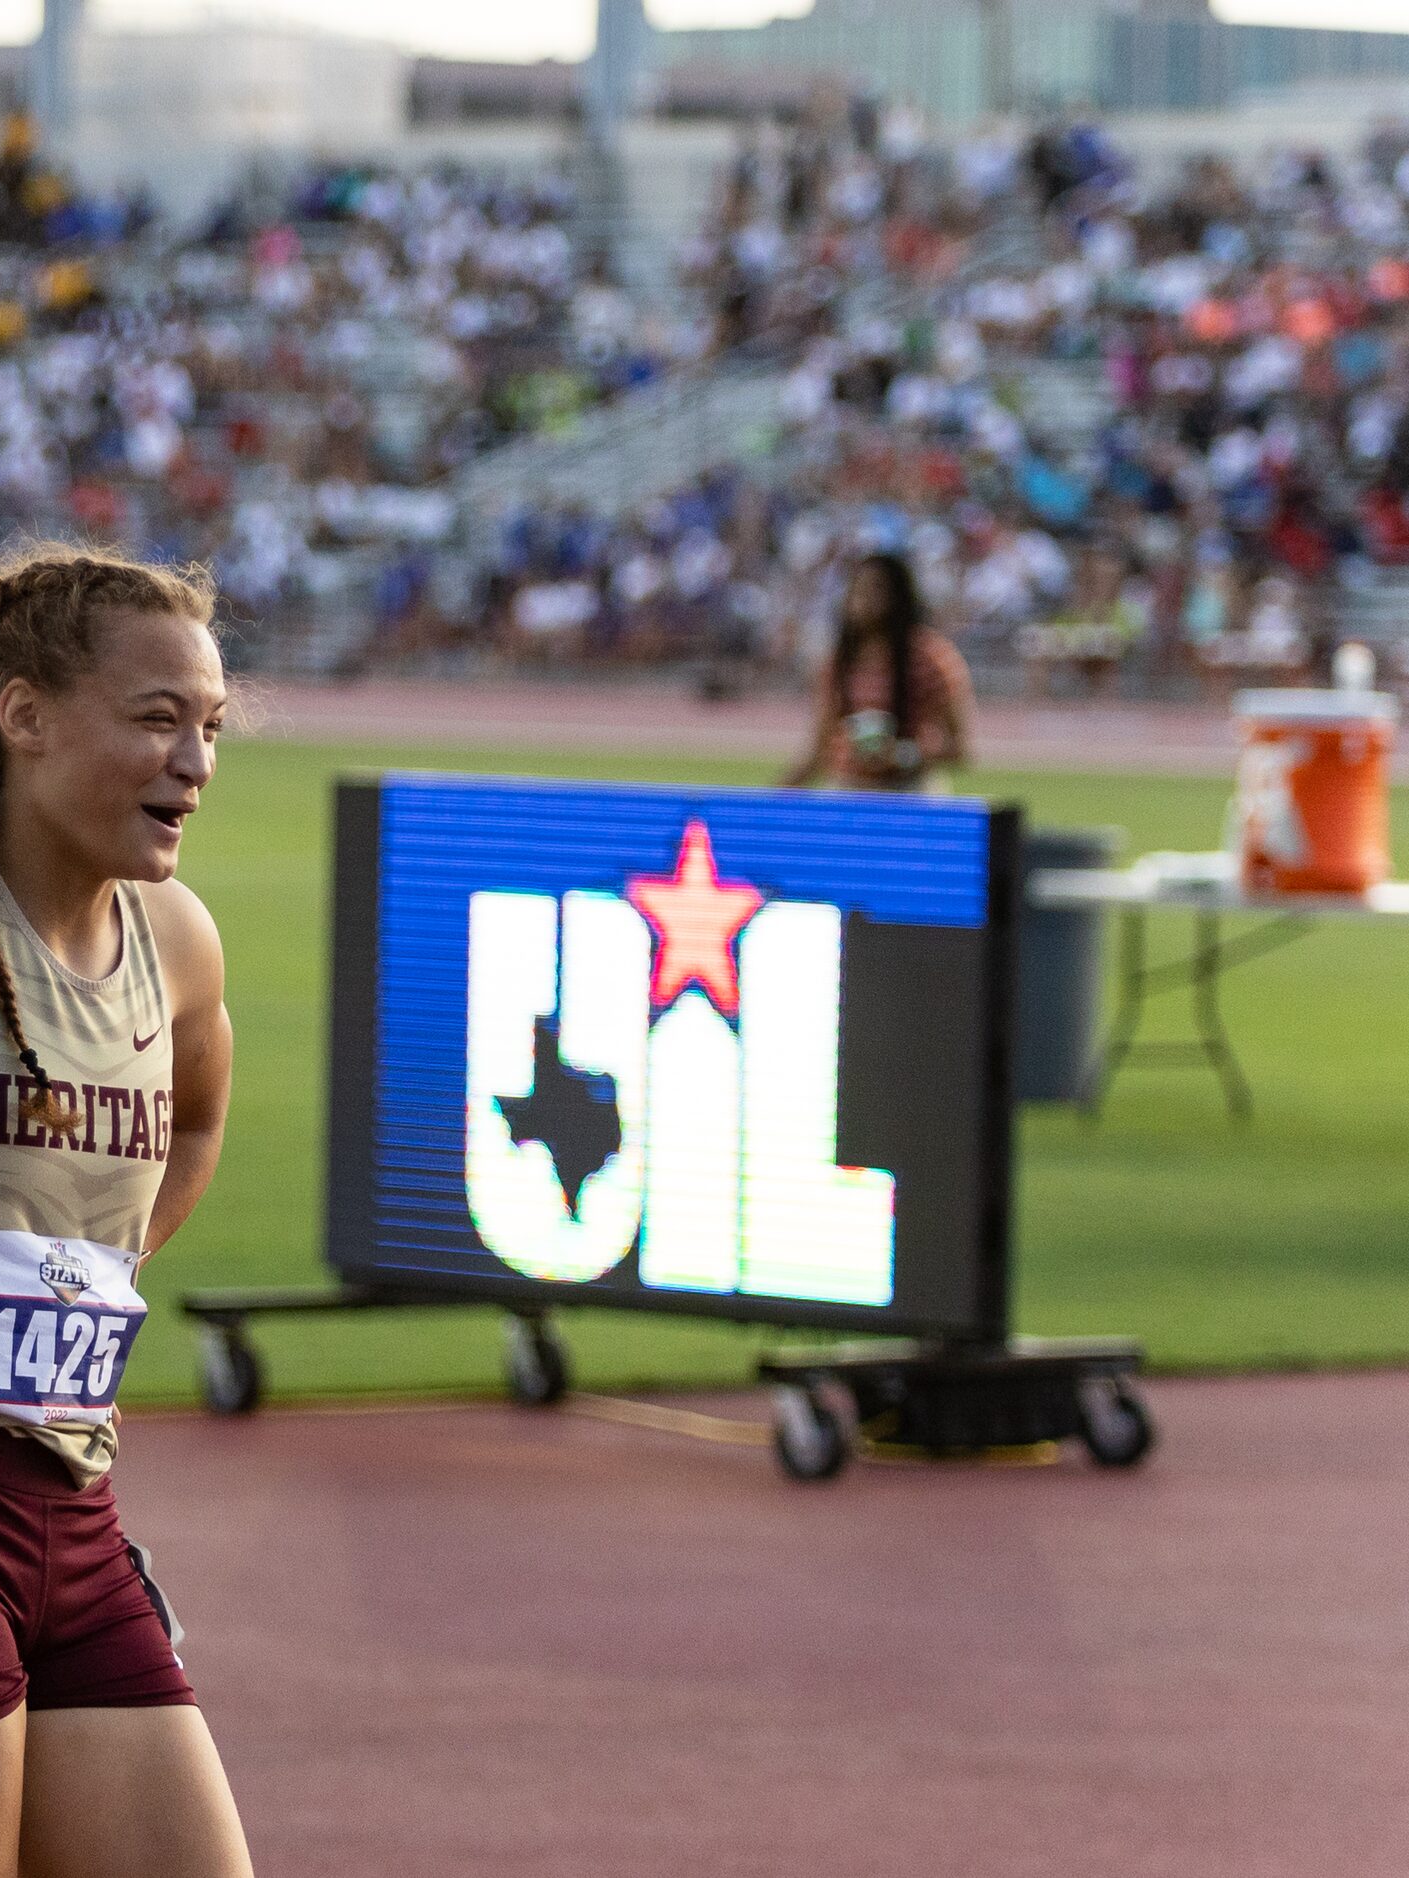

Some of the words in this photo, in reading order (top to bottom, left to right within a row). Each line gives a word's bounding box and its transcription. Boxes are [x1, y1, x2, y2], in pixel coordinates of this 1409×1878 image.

[466, 885, 894, 1306] UIL
[41, 1263, 91, 1286] STATE
[44, 1409, 68, 1421] 2022
